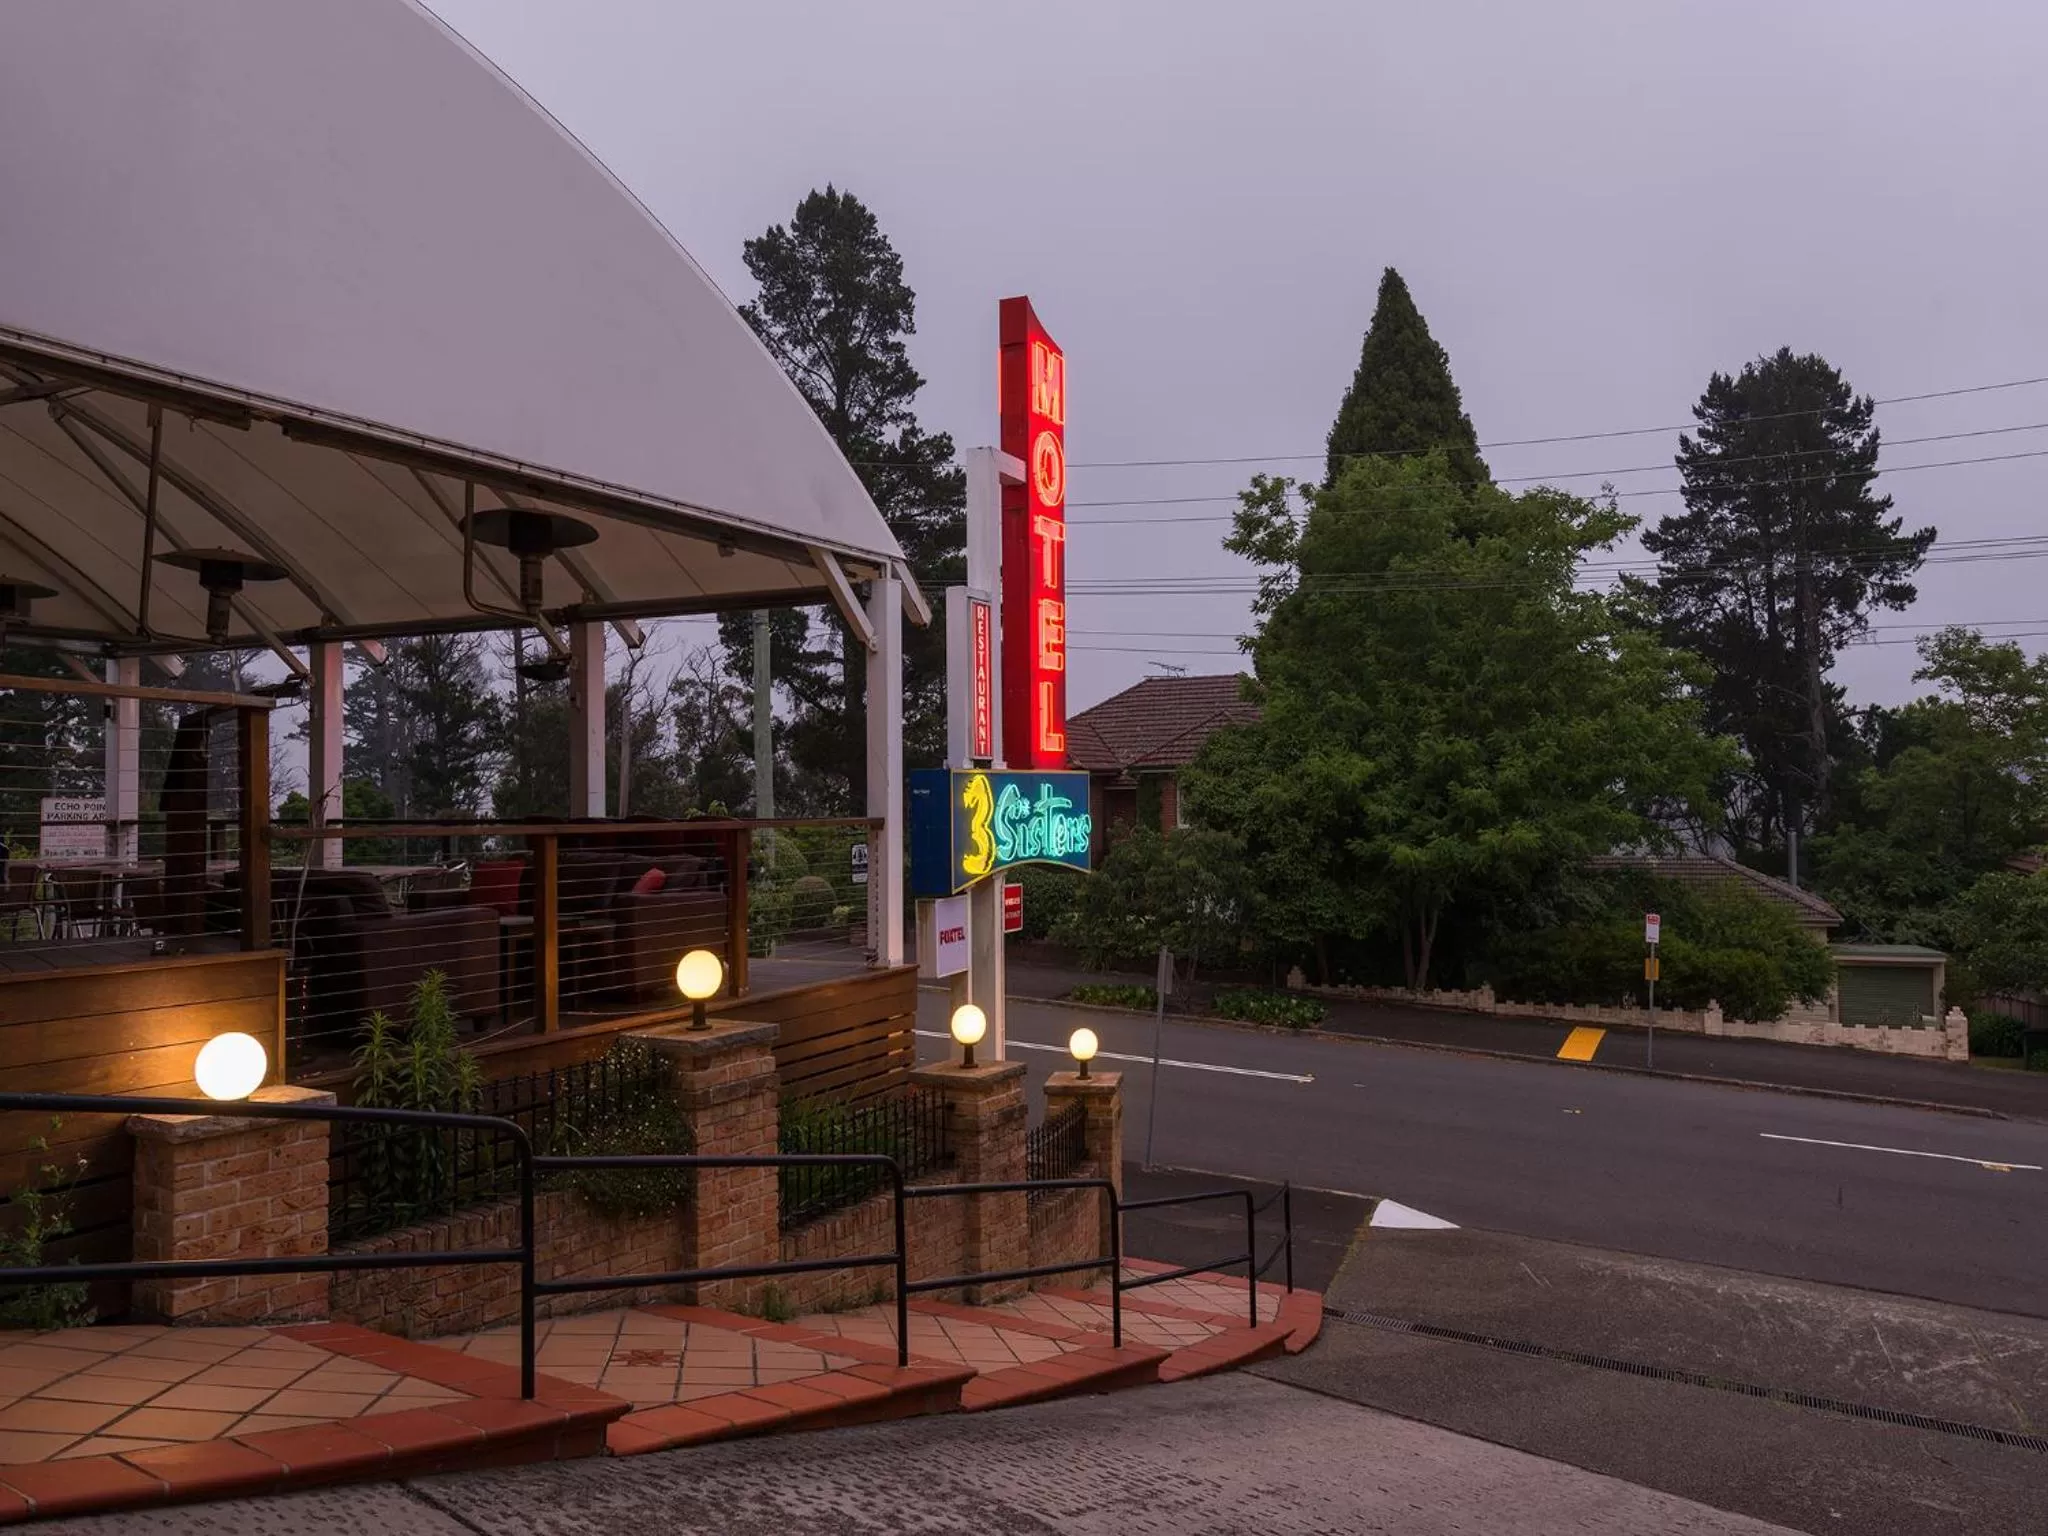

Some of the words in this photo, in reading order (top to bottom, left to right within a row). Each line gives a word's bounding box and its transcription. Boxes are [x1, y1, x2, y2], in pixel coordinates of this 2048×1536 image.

[1032, 341, 1066, 753] MOTEL
[976, 605, 987, 755] RESTAURANT
[47, 812, 89, 820] PARKING
[92, 812, 106, 820] AR
[54, 802, 80, 811] ECHO
[84, 803, 106, 812] POIN
[994, 782, 1092, 862] Sisters
